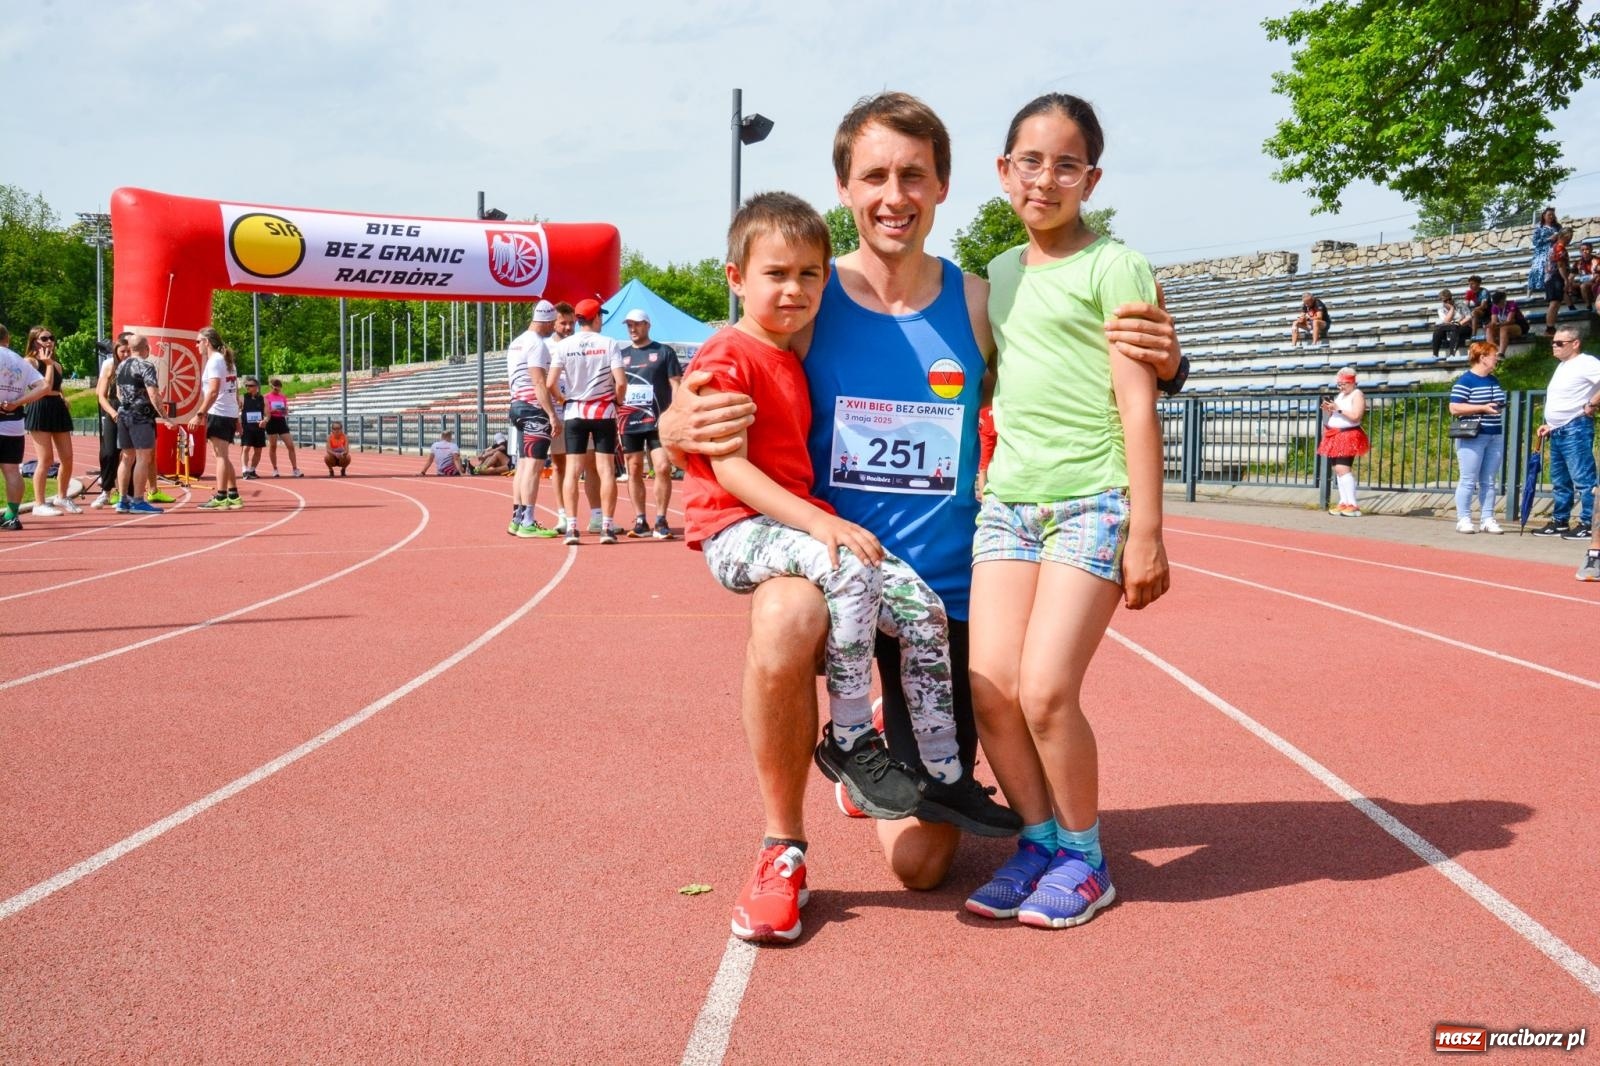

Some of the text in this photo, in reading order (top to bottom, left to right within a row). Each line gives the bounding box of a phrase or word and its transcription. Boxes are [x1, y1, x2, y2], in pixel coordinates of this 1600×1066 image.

[264, 222, 303, 237] SIR
[366, 222, 421, 237] BIEG
[324, 241, 465, 264] BEZ GRANIC
[335, 267, 454, 287] RACIBÓRZ
[846, 400, 954, 416] XVII BIEG BEZ GRANIC
[851, 415, 871, 424] maja
[873, 416, 893, 424] 2025
[867, 437, 926, 470] 251
